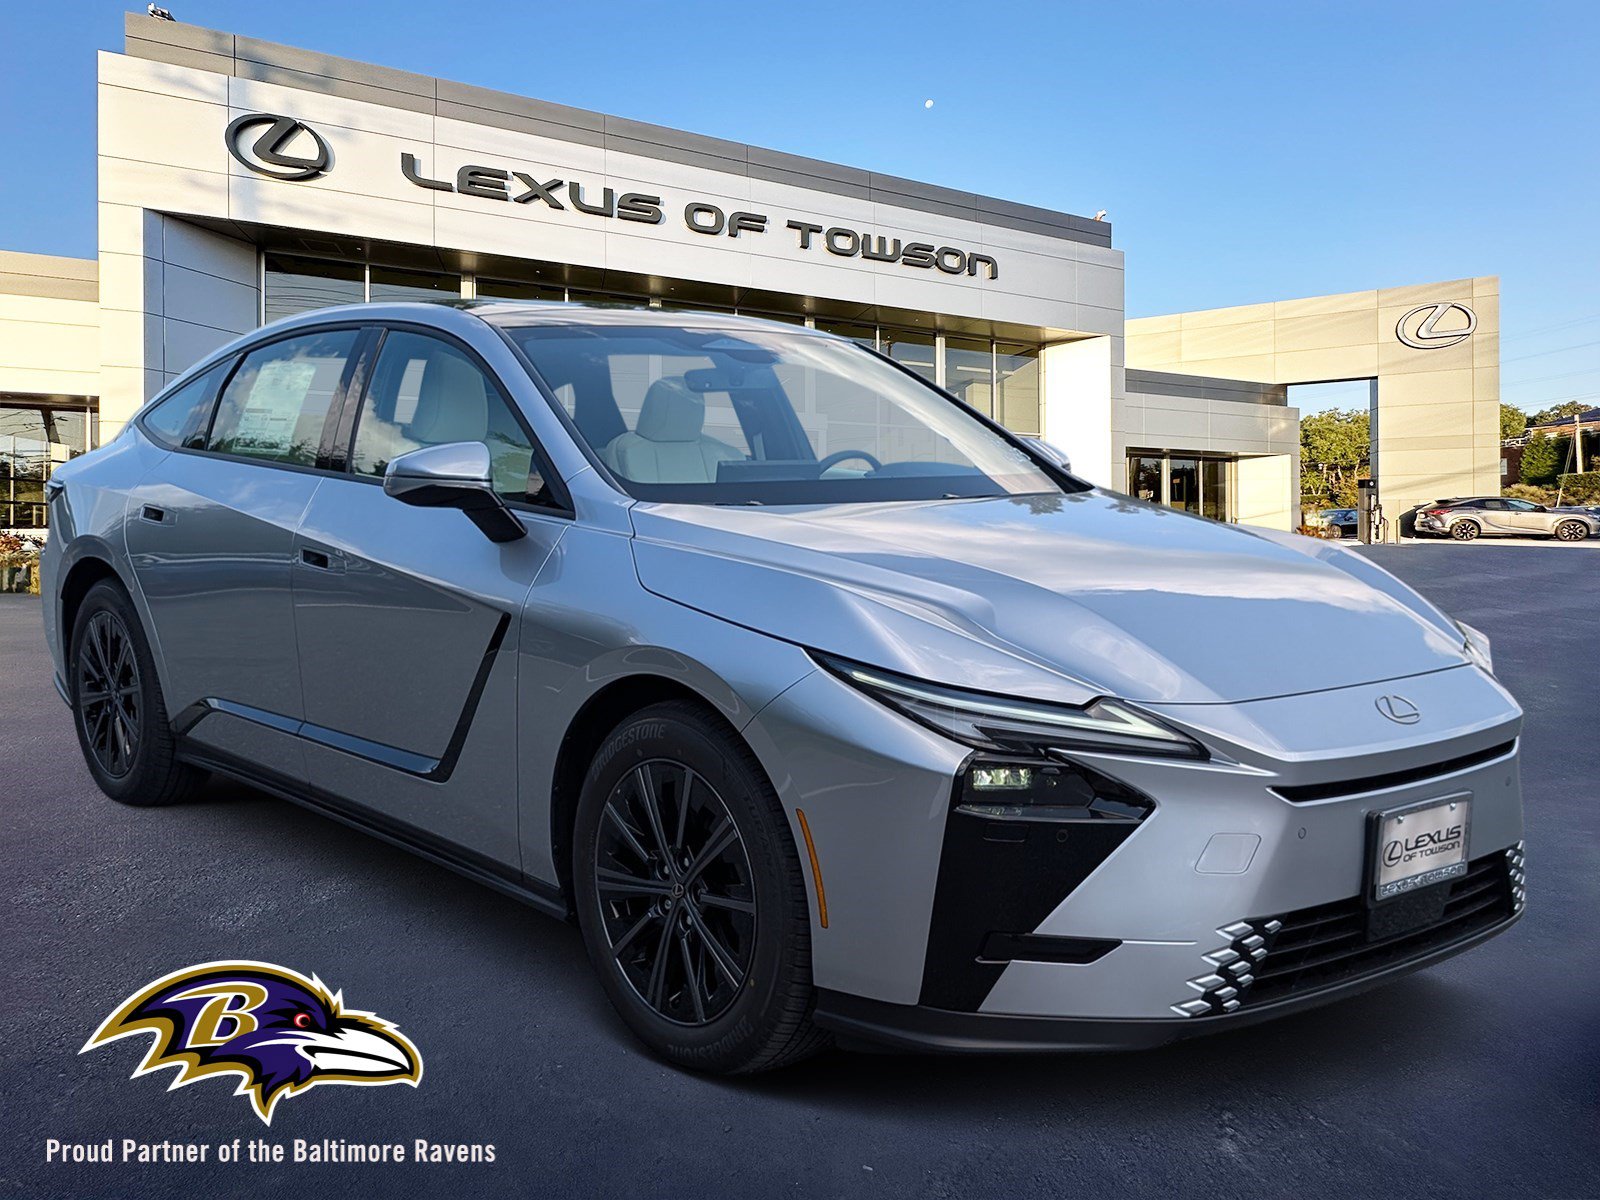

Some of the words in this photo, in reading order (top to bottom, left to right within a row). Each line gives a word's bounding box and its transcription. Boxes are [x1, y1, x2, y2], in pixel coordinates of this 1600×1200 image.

[401, 152, 663, 225] LEXUS
[684, 202, 767, 237] OF
[786, 219, 999, 280] TOWSON
[591, 723, 666, 782] BRIDGESTONE
[1403, 851, 1417, 862] OF
[1419, 841, 1460, 858] TOWSON
[1404, 825, 1461, 851] LEXUS
